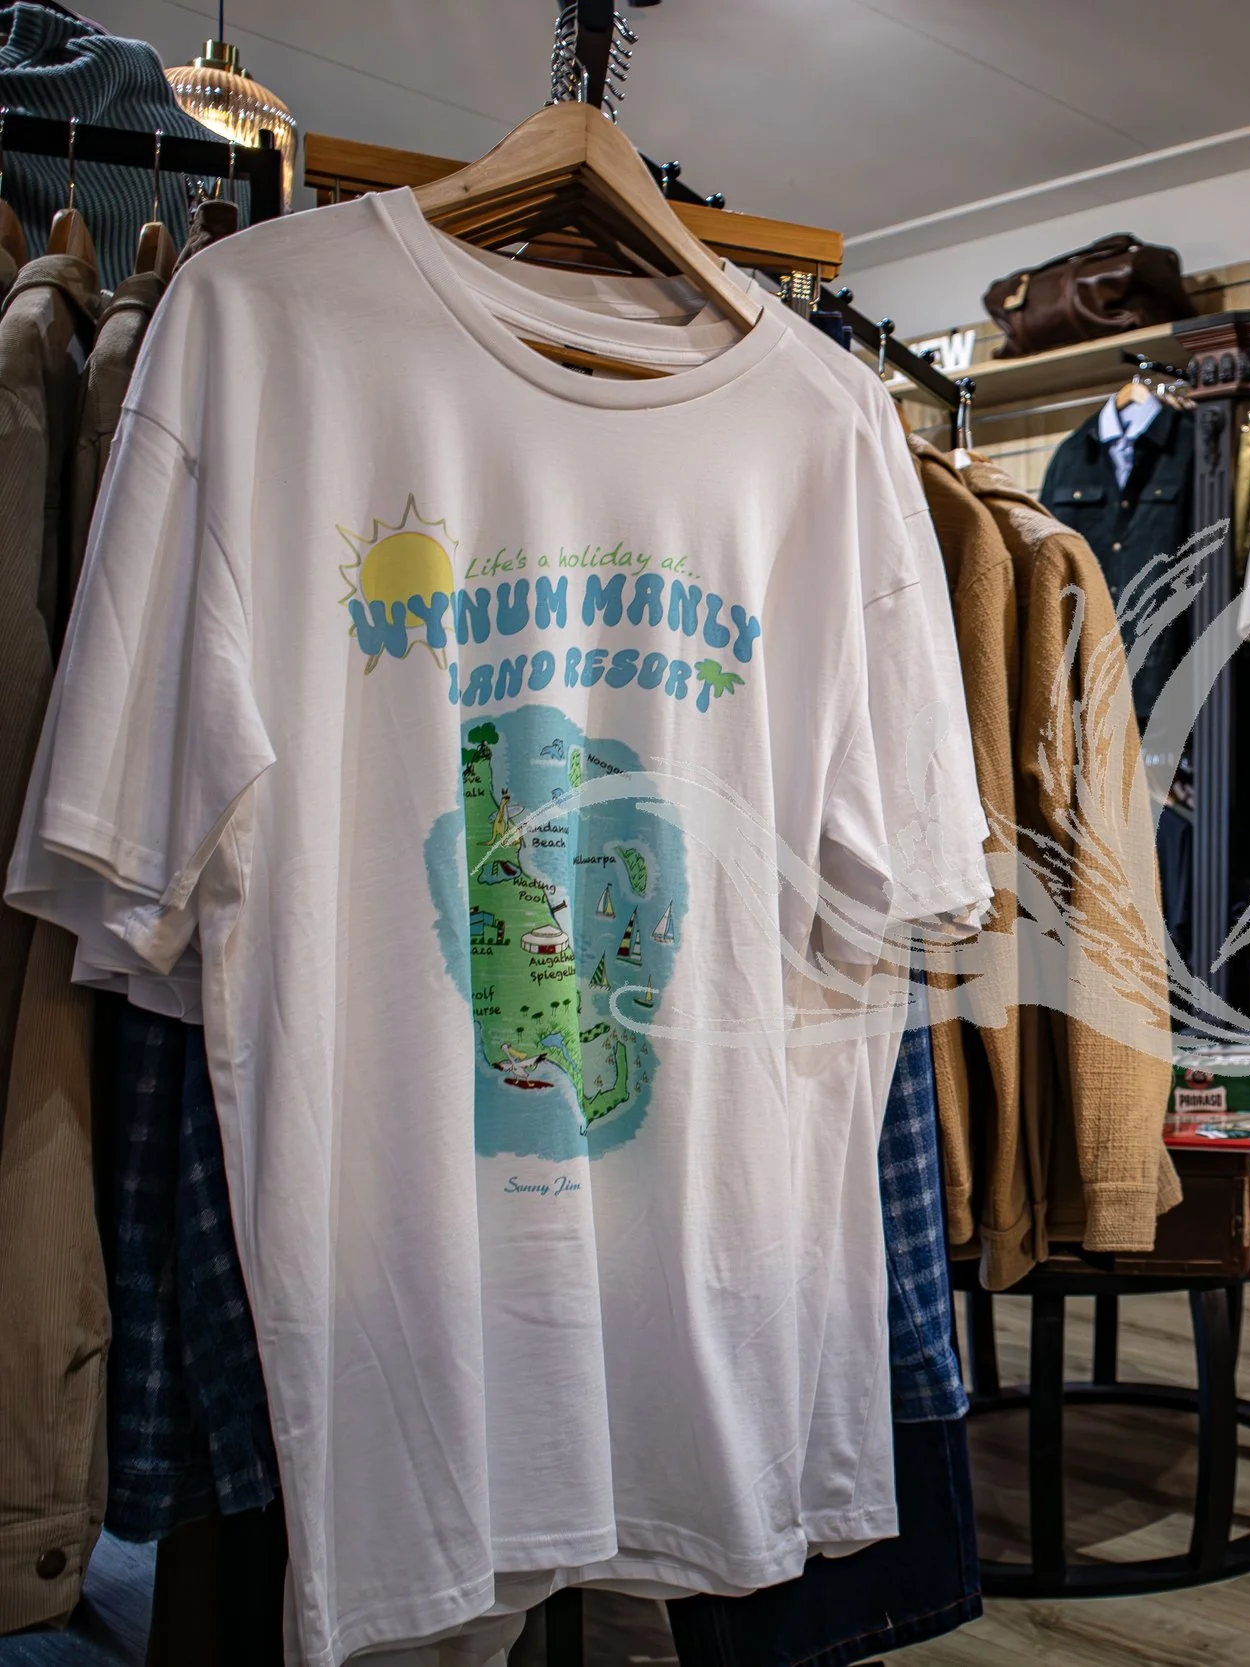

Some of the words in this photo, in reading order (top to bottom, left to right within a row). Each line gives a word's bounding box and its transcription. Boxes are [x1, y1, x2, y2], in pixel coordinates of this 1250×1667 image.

[465, 547, 527, 580] Life's
[538, 555, 550, 568] a
[559, 542, 652, 576] holiday
[581, 573, 761, 664] MANLY
[564, 647, 745, 713] RESORT
[532, 837, 566, 848] Beach
[513, 877, 556, 895] Wading
[519, 890, 546, 904] Pool
[1180, 1093, 1223, 1108] PRORASO
[554, 1176, 581, 1196] Jim
